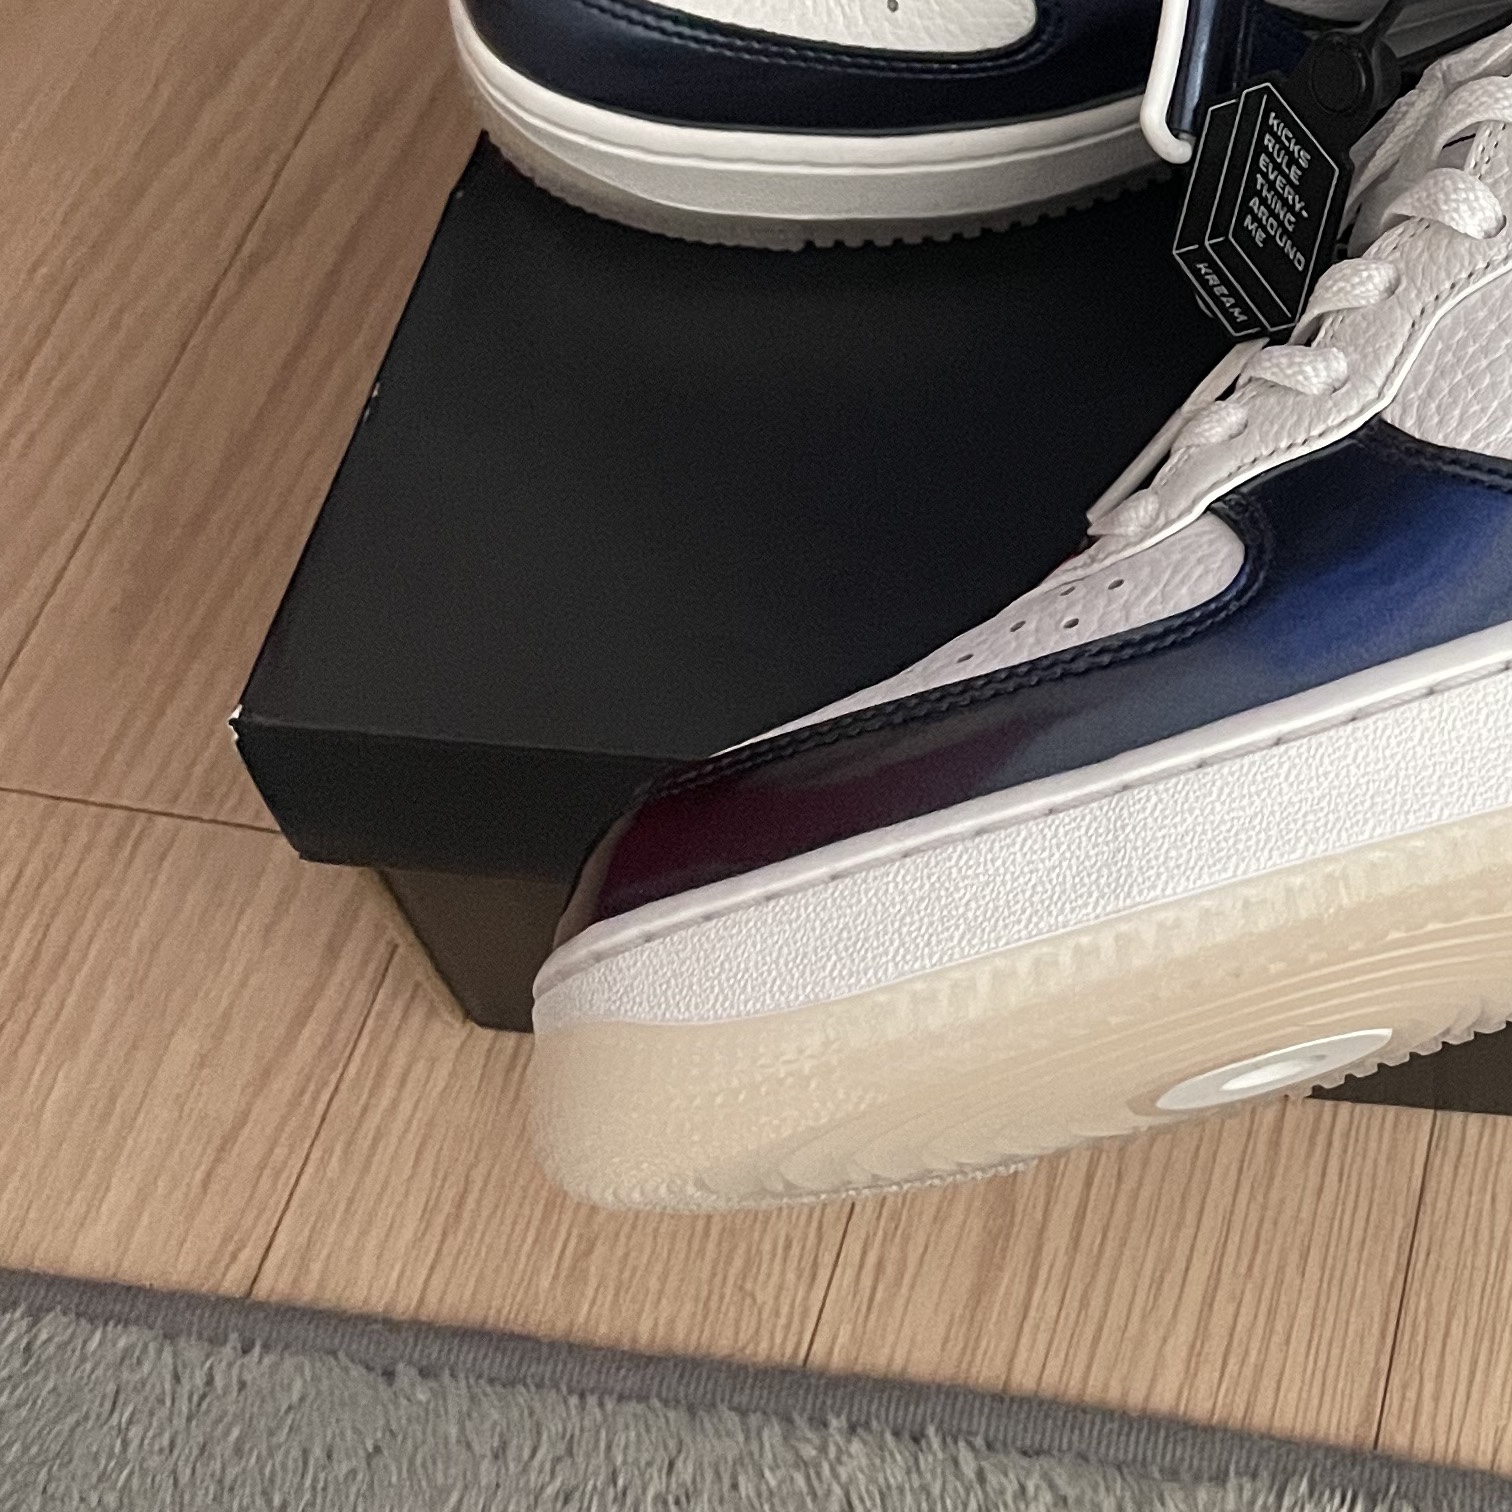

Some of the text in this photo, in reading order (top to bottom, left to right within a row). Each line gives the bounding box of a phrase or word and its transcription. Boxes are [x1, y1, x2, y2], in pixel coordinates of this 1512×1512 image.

[1263, 132, 1302, 186] RULE
[1268, 111, 1311, 169] KICKS
[1256, 173, 1295, 232] THING
[1258, 153, 1309, 219] EVERY-
[1243, 214, 1267, 248] ME
[1249, 196, 1306, 272] AROUND
[1196, 262, 1248, 324] KREAM
